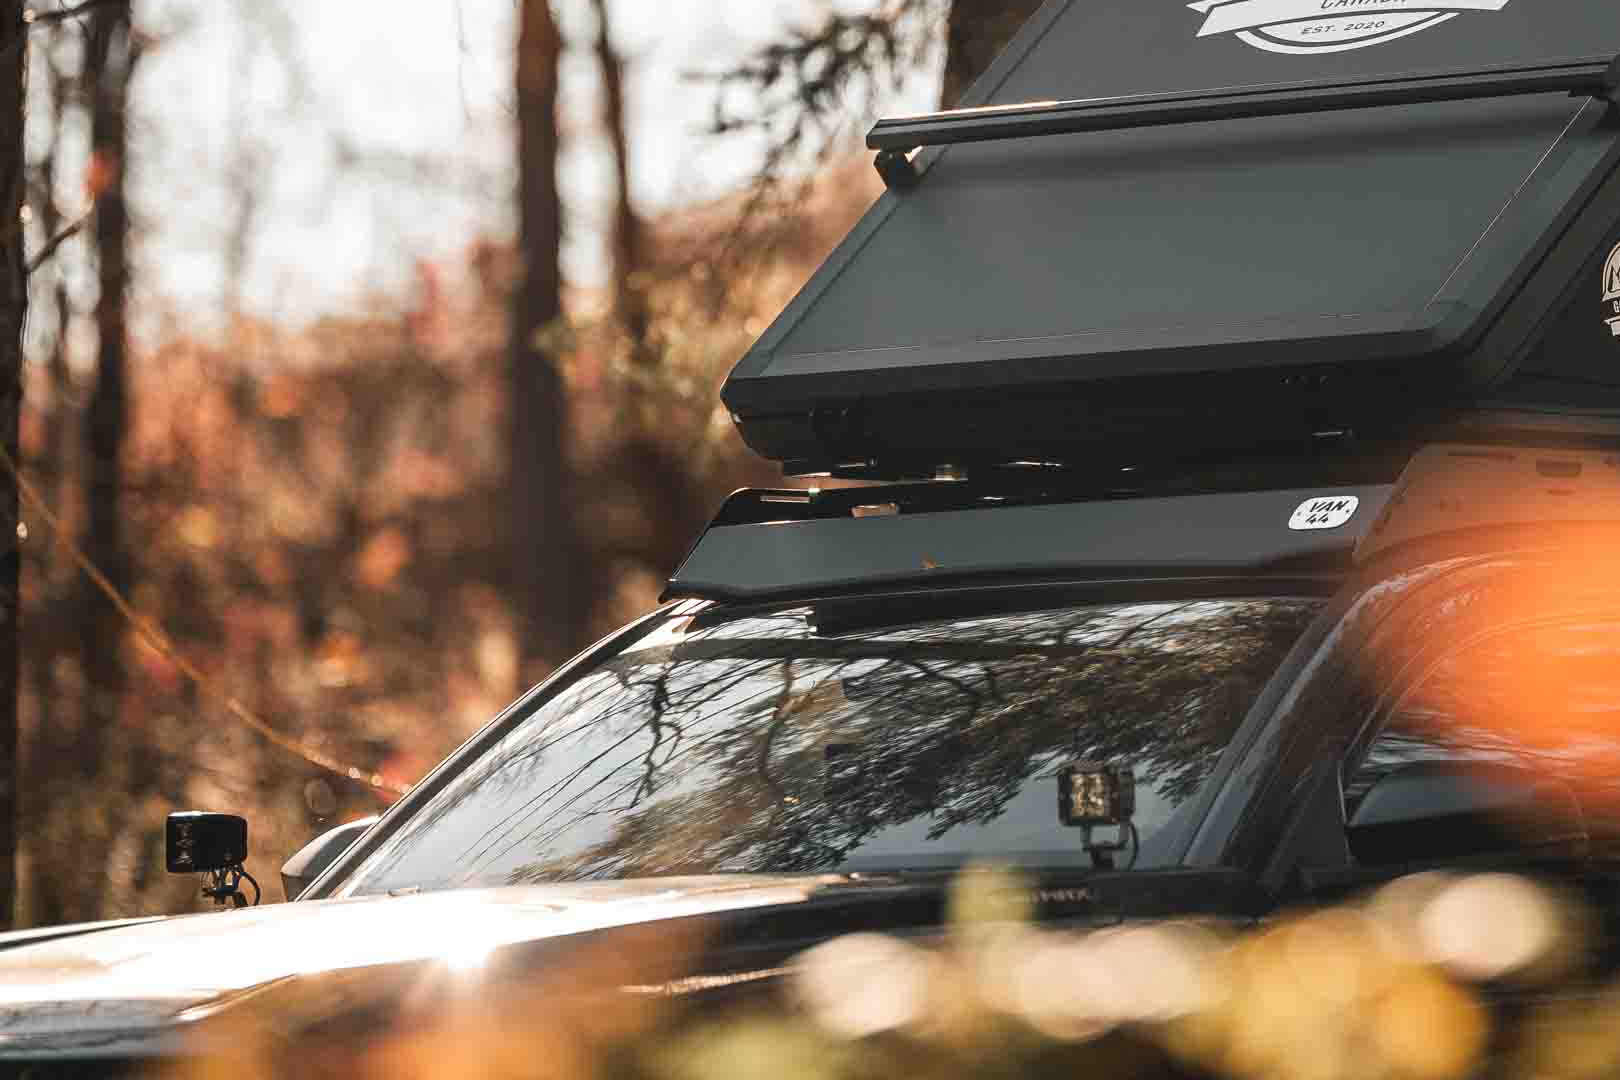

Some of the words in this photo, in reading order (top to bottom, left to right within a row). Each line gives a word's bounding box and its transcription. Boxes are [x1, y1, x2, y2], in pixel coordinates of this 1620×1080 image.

[1300, 24, 1337, 35] EST.
[1343, 20, 1385, 32] 2020
[1309, 500, 1349, 512] VAN
